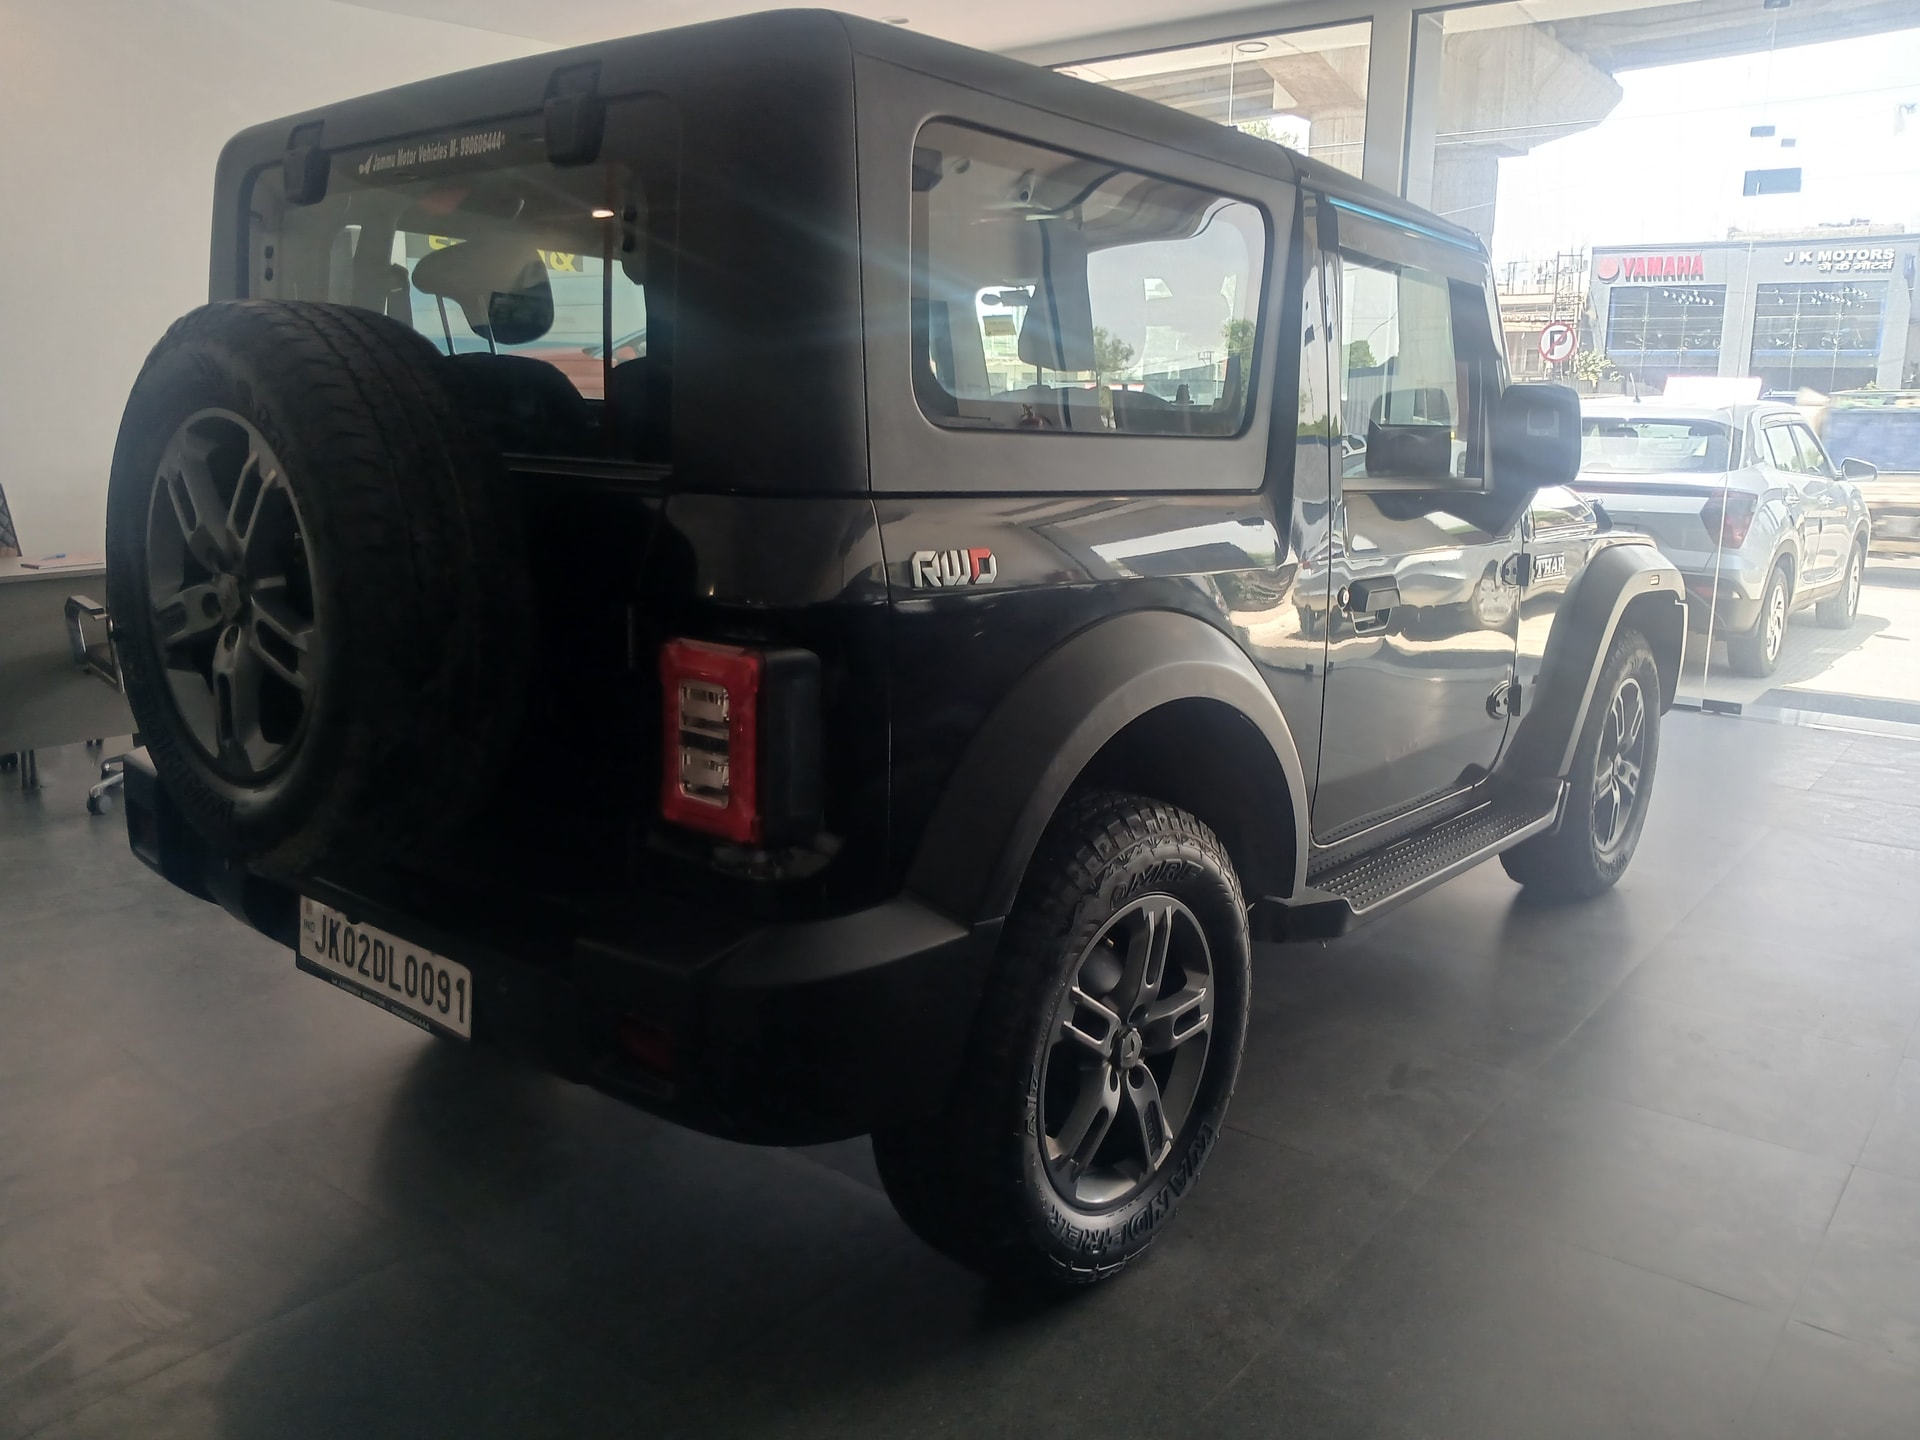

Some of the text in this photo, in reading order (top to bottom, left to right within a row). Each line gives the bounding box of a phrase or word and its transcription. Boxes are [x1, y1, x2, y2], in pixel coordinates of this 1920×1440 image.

[372, 151, 396, 172] Jammu
[396, 147, 417, 167] Motor
[418, 141, 448, 163] Vehicles
[1622, 254, 1704, 283] YAMAHA
[1783, 247, 1895, 264] J K MOTORS
[1549, 329, 1568, 356] P
[911, 548, 998, 588] RWD
[314, 913, 466, 1025] JK02DL0091
[1045, 1120, 1215, 1256] WANDERER
